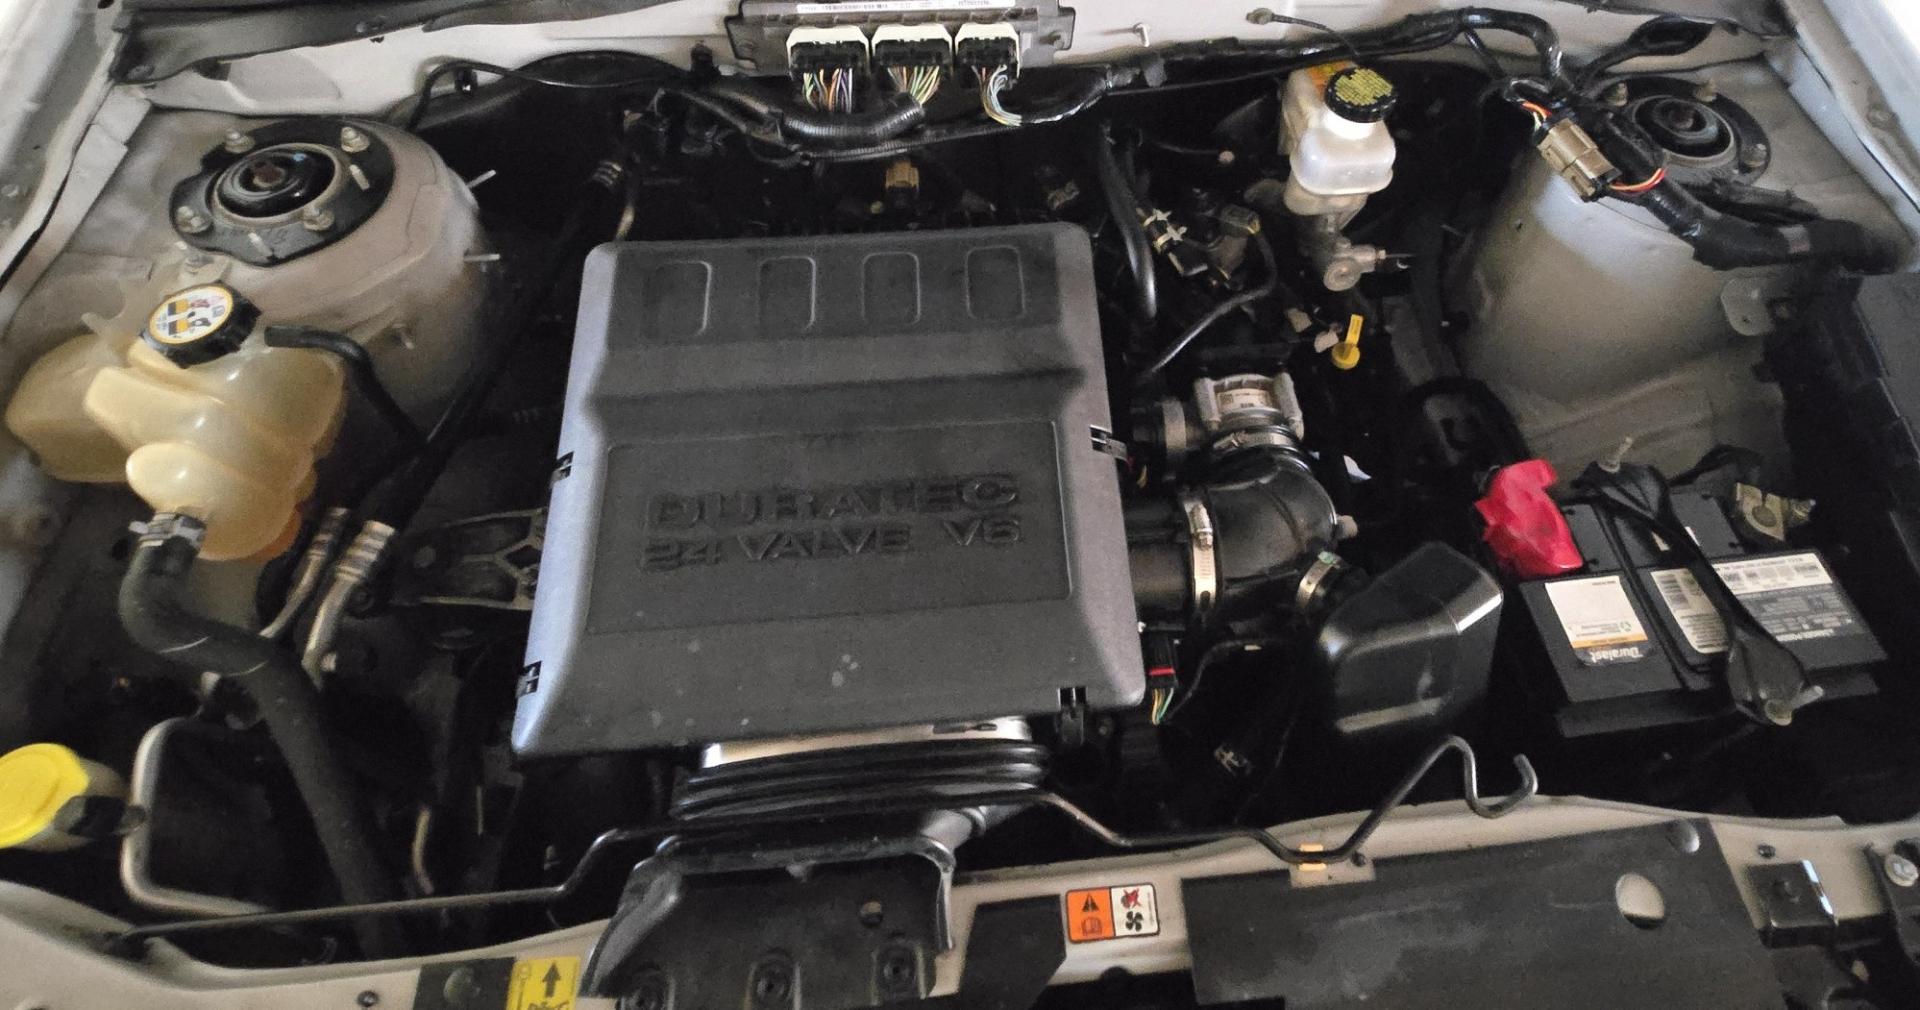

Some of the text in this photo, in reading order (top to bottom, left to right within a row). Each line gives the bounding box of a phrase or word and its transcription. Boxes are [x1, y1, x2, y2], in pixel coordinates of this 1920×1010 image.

[645, 474, 1018, 528] DURATEC
[642, 515, 1021, 571] 24 VALVE V6
[1589, 646, 1644, 663] Duralast
